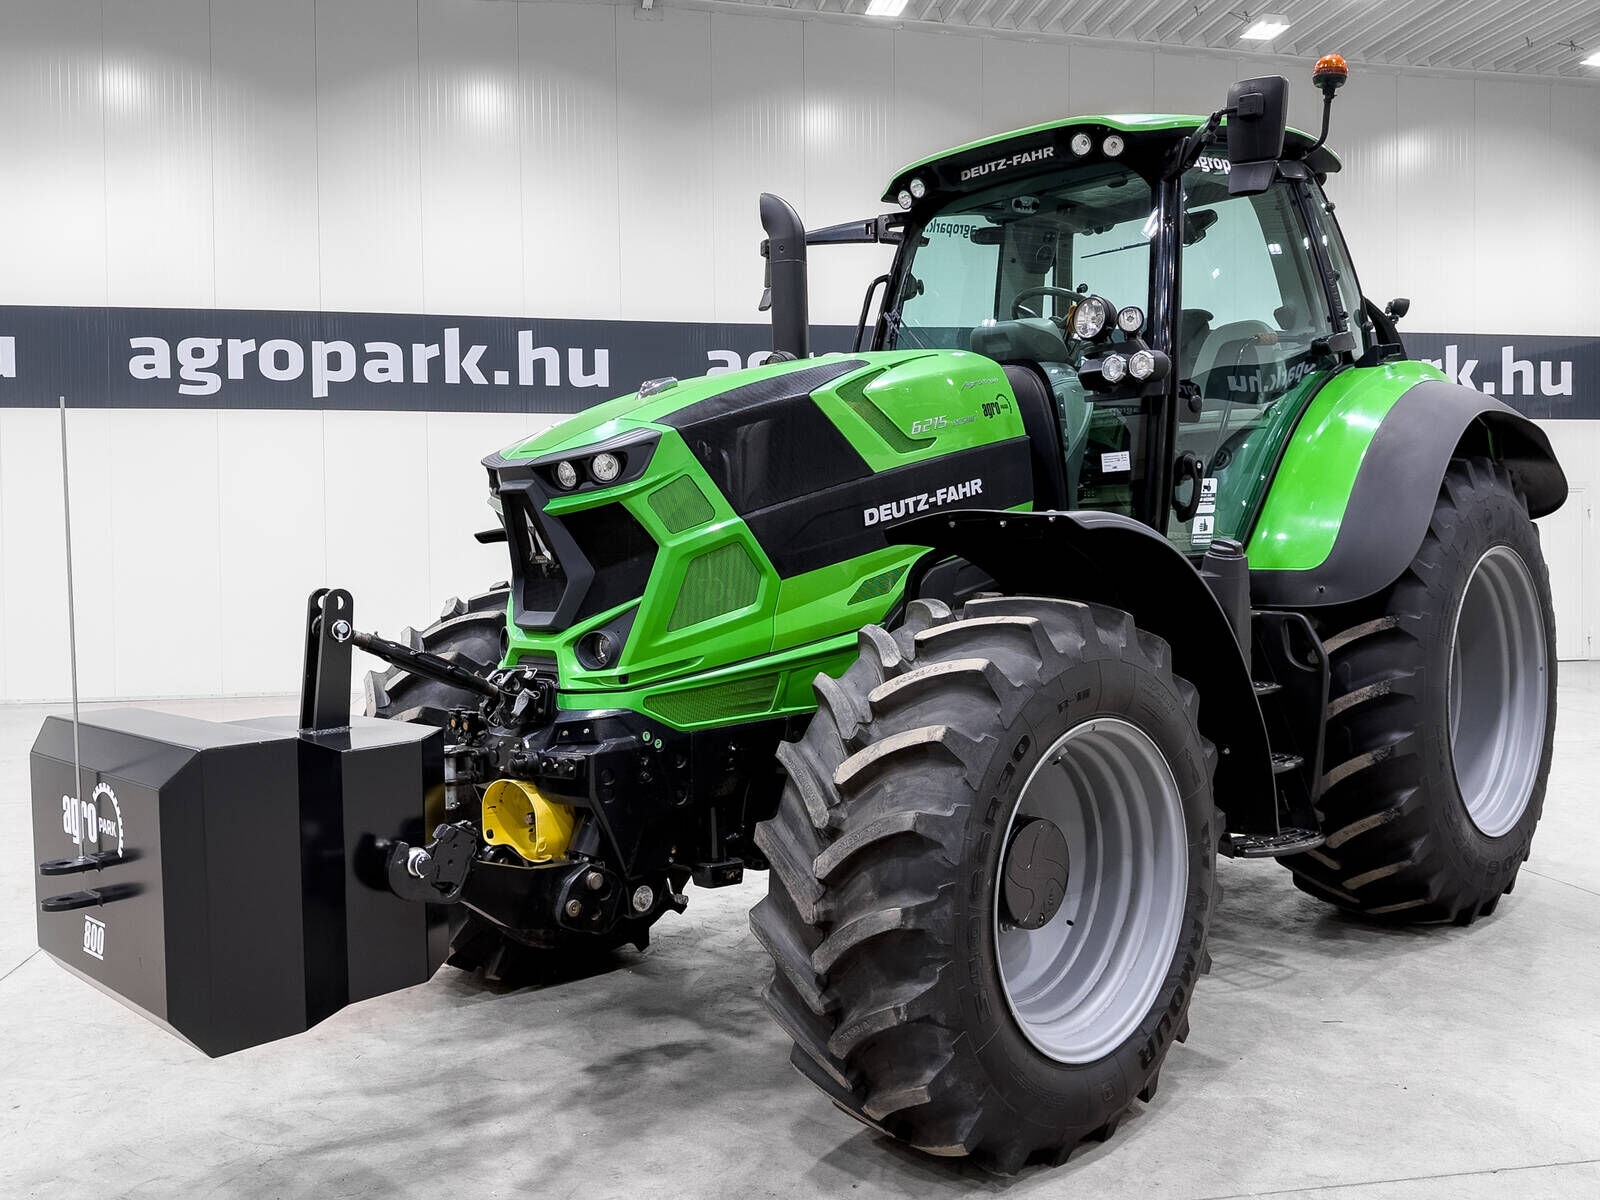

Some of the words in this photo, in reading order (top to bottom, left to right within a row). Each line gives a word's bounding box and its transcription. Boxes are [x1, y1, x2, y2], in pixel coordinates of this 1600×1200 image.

[960, 146, 1054, 182] DEUTZ-FAHR
[128, 327, 610, 398] agropark.hu
[911, 415, 947, 435] 6215
[981, 401, 1001, 419] agro
[863, 478, 983, 527] DEUTZ-FAHR
[62, 794, 97, 845] agro
[98, 817, 118, 838] PARK
[83, 920, 106, 956] 800
